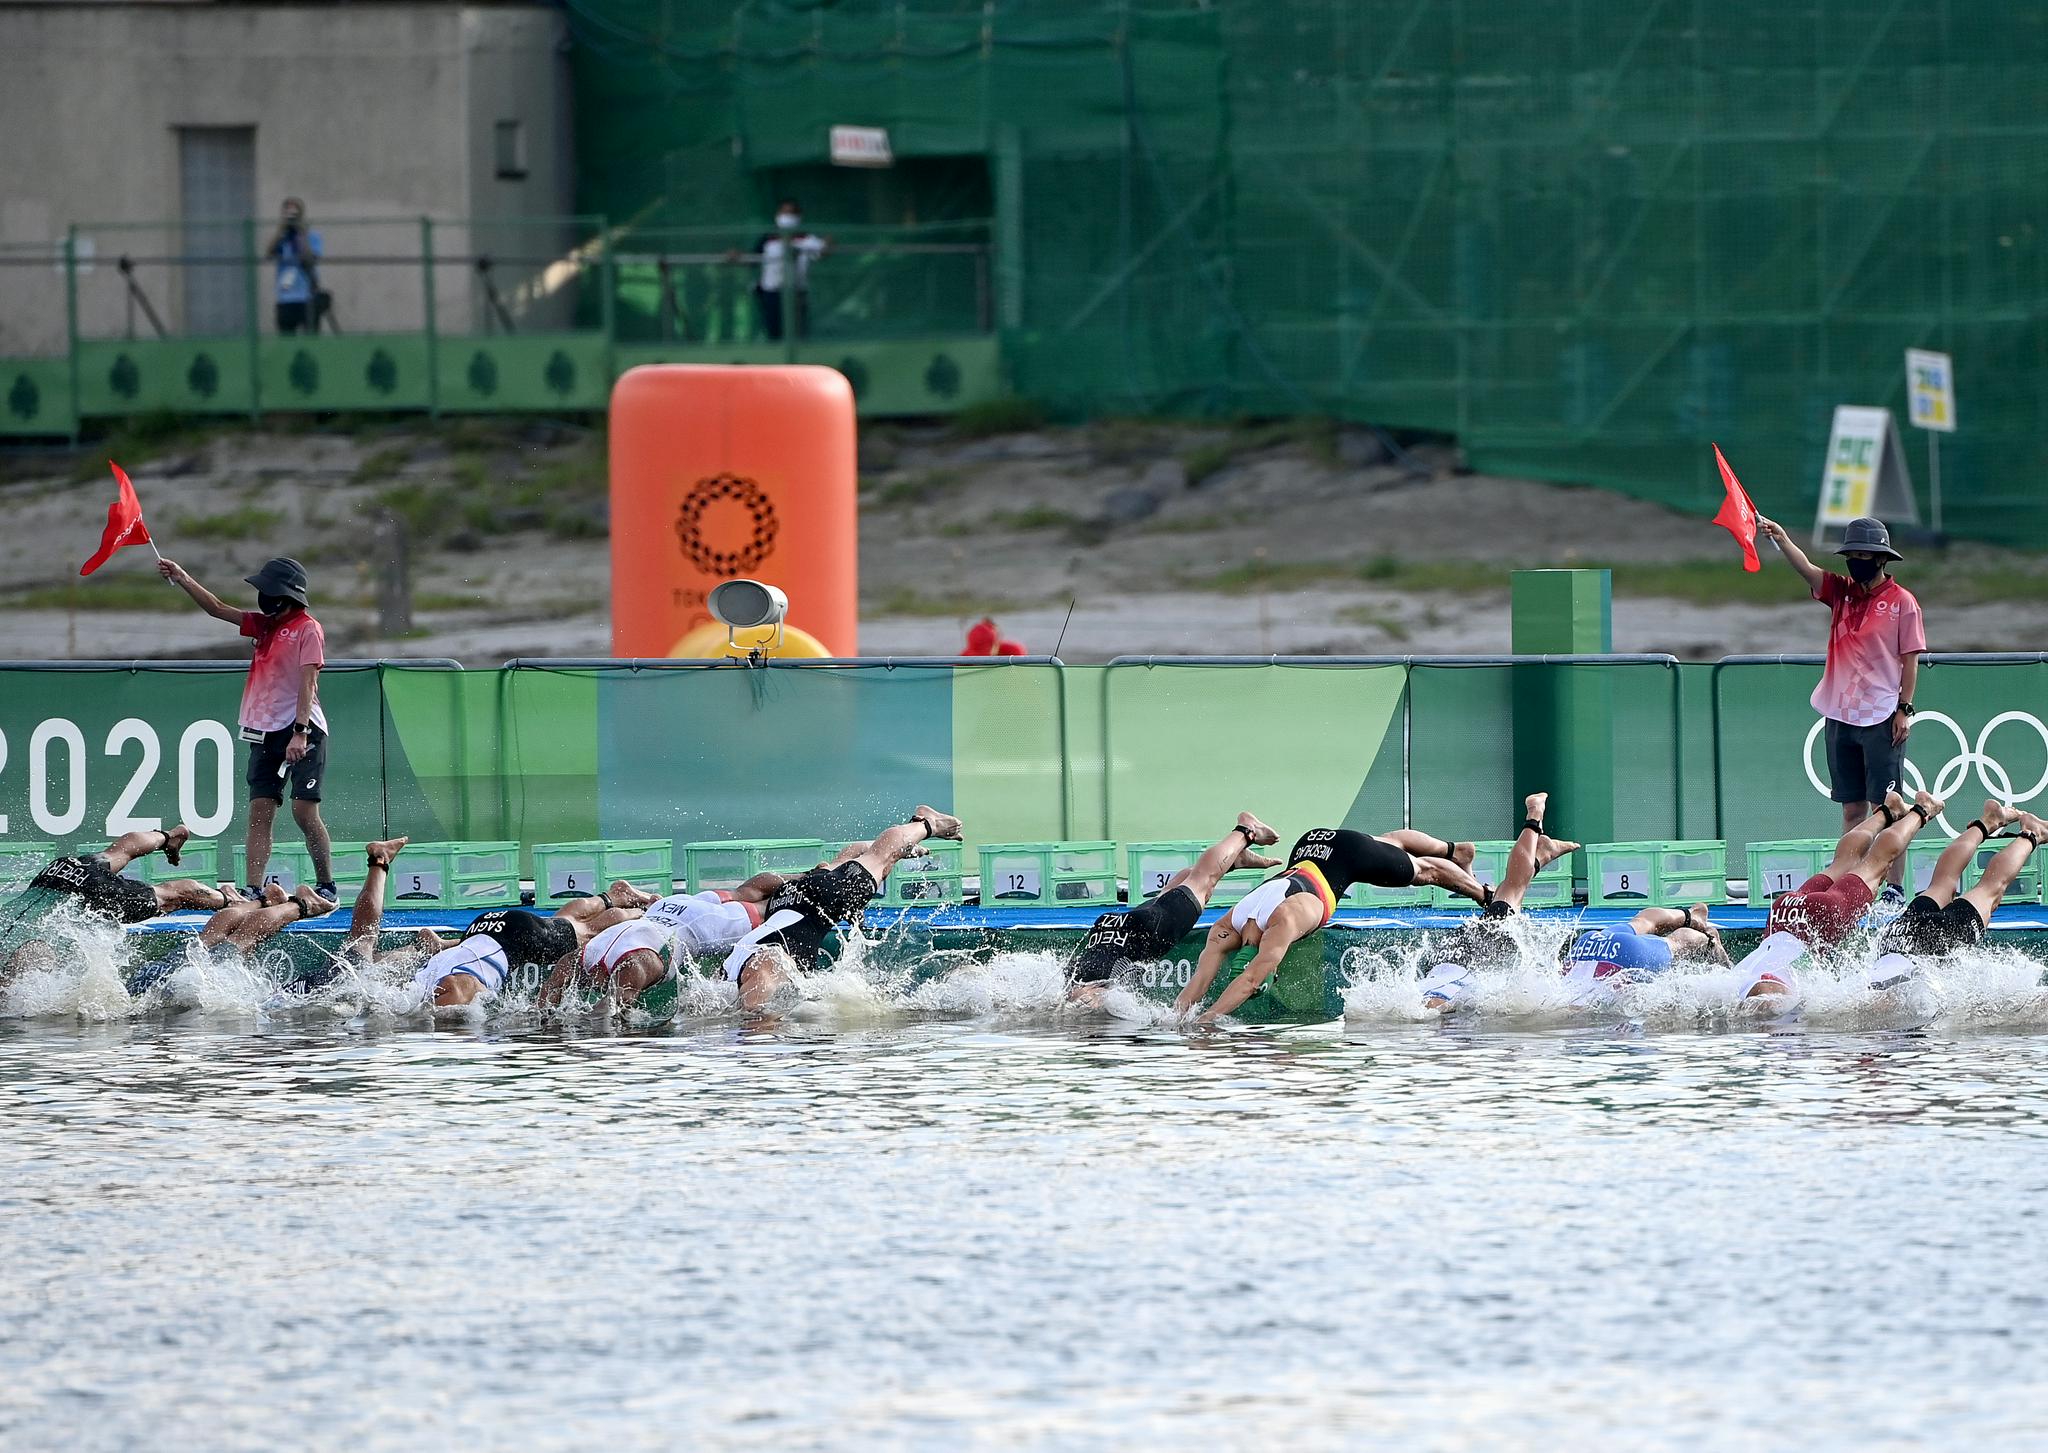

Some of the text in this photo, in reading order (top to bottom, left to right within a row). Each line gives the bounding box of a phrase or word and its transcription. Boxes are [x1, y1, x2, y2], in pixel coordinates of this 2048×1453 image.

[0, 717, 234, 837] 020
[1307, 830, 1336, 841] GER
[1294, 843, 1333, 861] NIESCHLAG
[412, 875, 421, 891] 5
[567, 874, 576, 890] 6
[1008, 874, 1025, 890] 12
[1620, 874, 1630, 890] 8
[1777, 873, 1792, 890] 11
[657, 901, 688, 917] MEX
[1780, 895, 1807, 907] HUN
[466, 920, 506, 935] SAGIV
[1101, 914, 1128, 928] NZL
[1572, 937, 1622, 959] STATEFF
